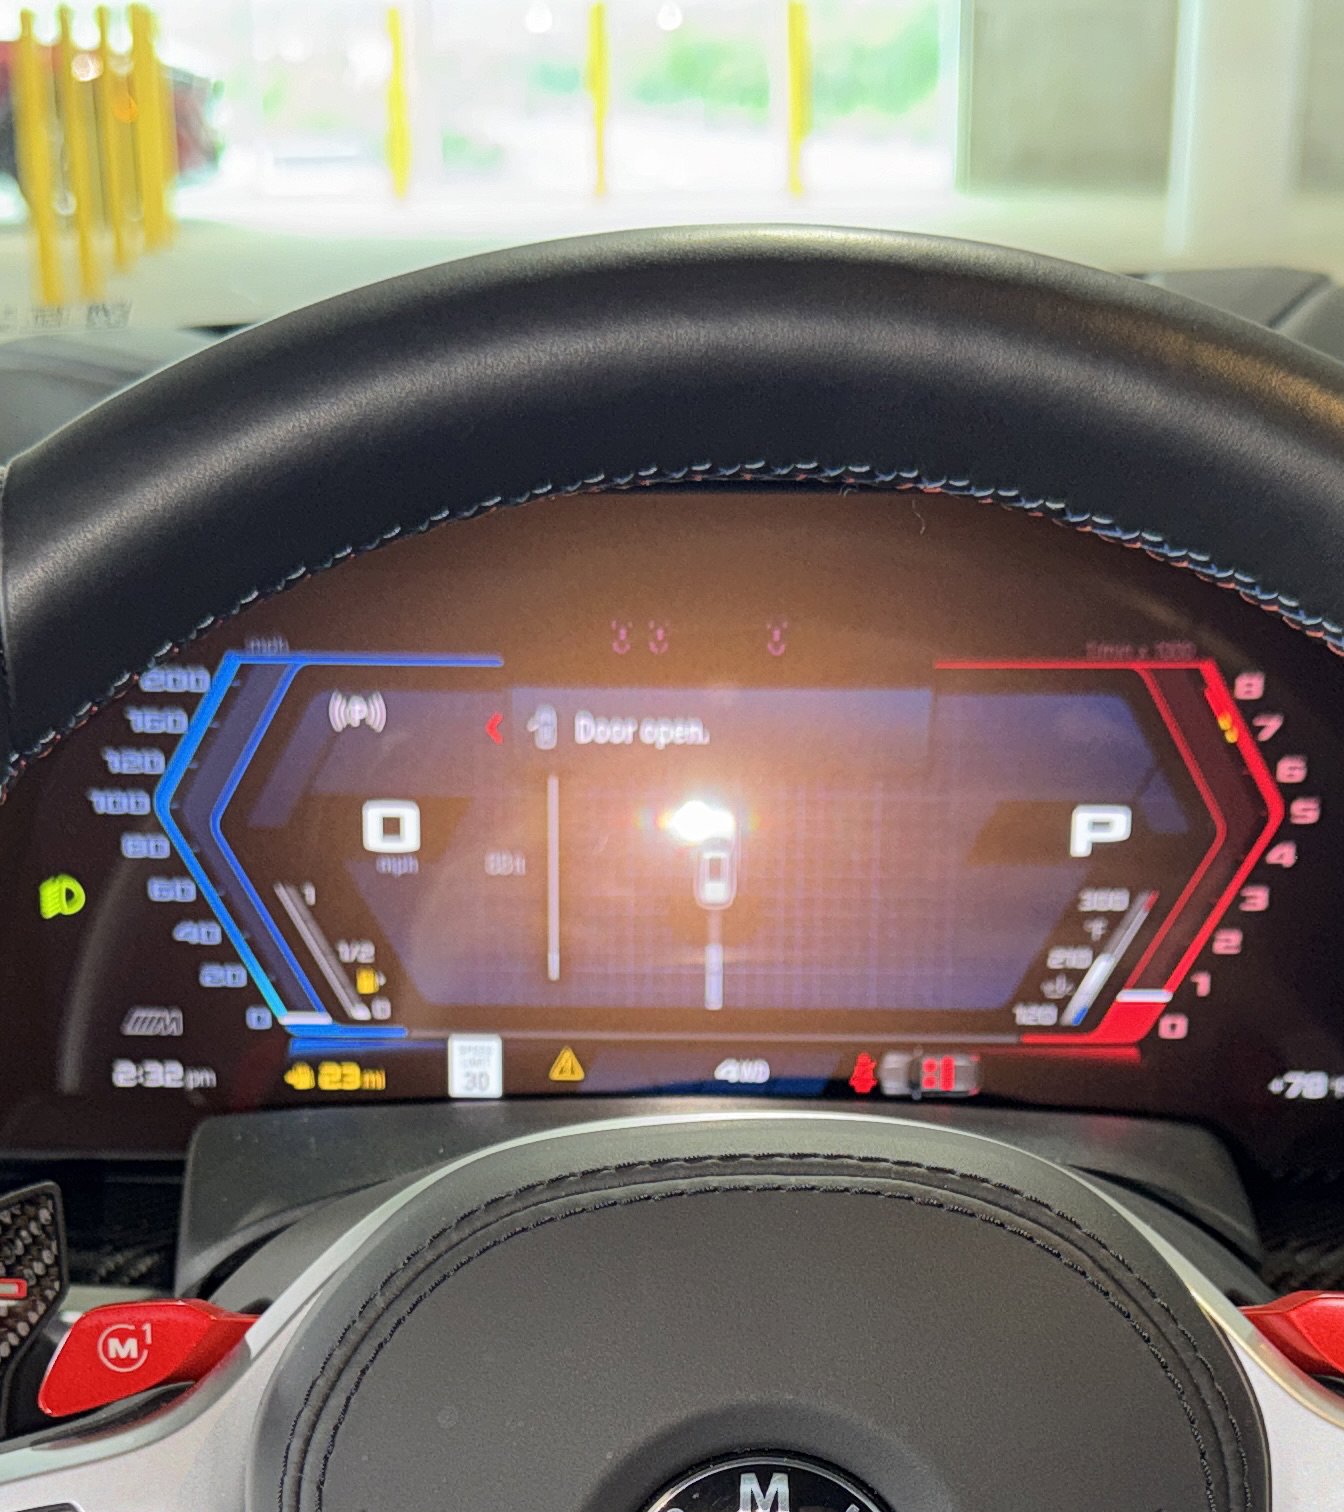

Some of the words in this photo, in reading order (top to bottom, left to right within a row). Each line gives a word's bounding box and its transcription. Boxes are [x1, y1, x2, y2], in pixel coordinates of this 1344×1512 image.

[574, 710, 637, 744] Door
[639, 716, 710, 749] open.
[1253, 713, 1284, 741] 7
[87, 789, 151, 815] 100
[1290, 798, 1321, 825] 5
[1070, 805, 1132, 858] P
[1265, 842, 1297, 868] 4
[1239, 885, 1269, 912] 3
[1212, 928, 1243, 955] 2
[1191, 971, 1211, 997] 1
[1158, 1014, 1188, 1039] 0
[714, 1058, 770, 1083] 4WD
